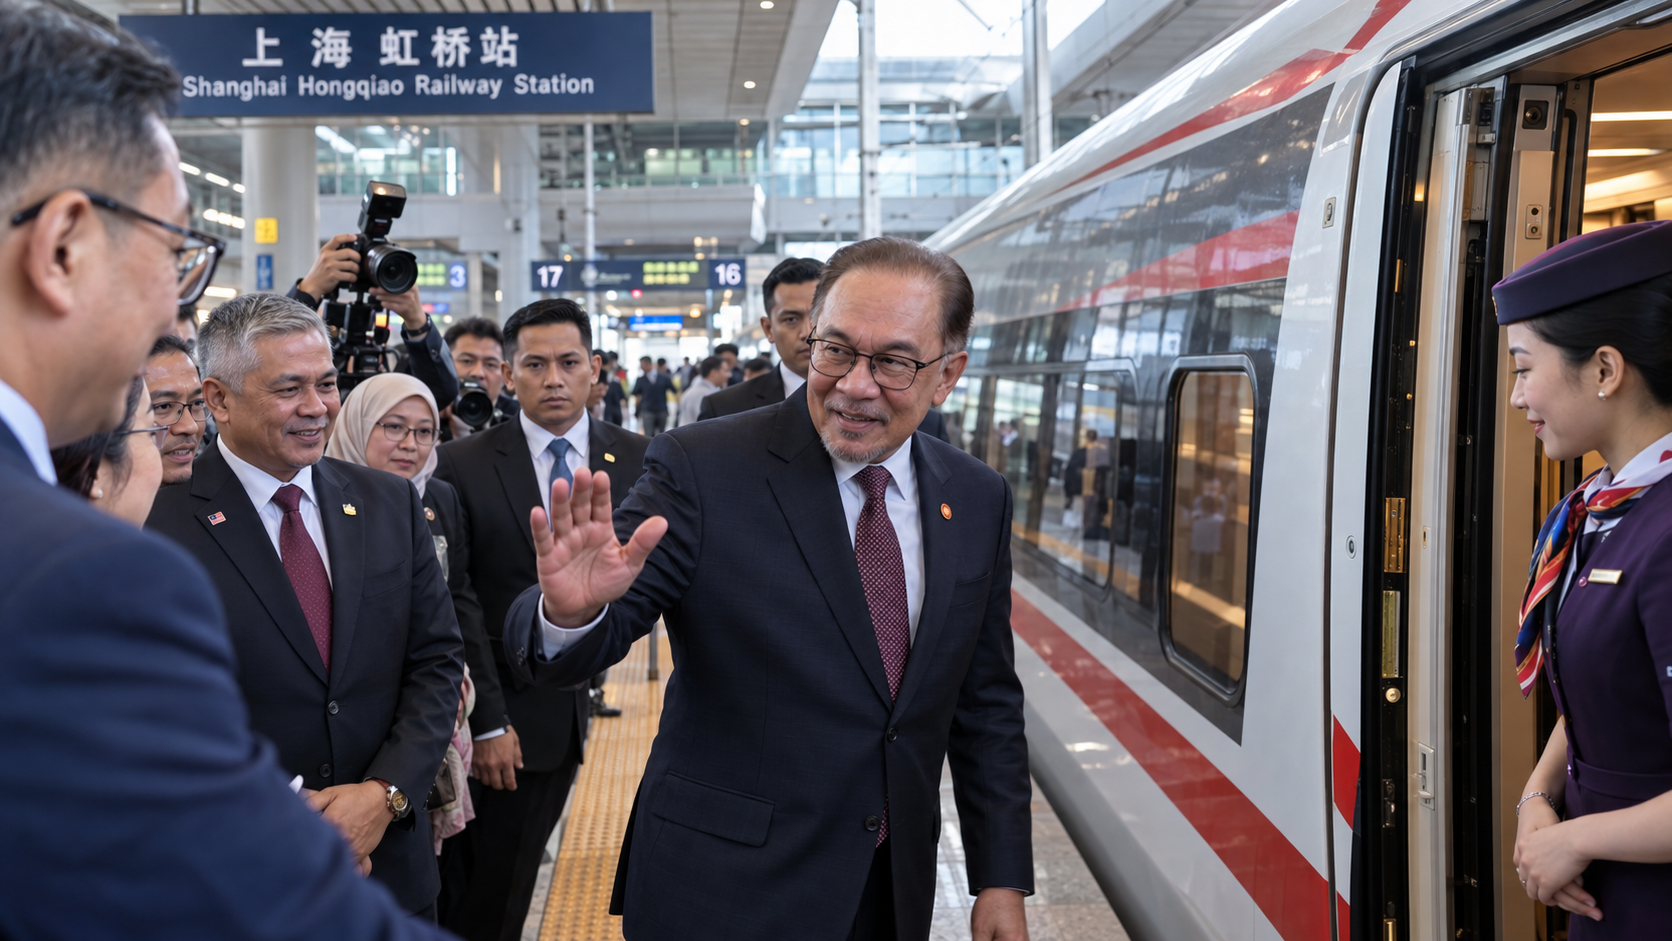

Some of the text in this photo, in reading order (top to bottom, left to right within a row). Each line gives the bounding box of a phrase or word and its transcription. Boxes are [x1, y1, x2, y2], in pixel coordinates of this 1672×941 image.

[243, 26, 519, 68] 上海虹桥站
[182, 73, 594, 101] Shanghai Hongqiao Railway Station
[449, 264, 466, 288] 3
[536, 265, 564, 288] 17
[714, 263, 742, 286] 16
